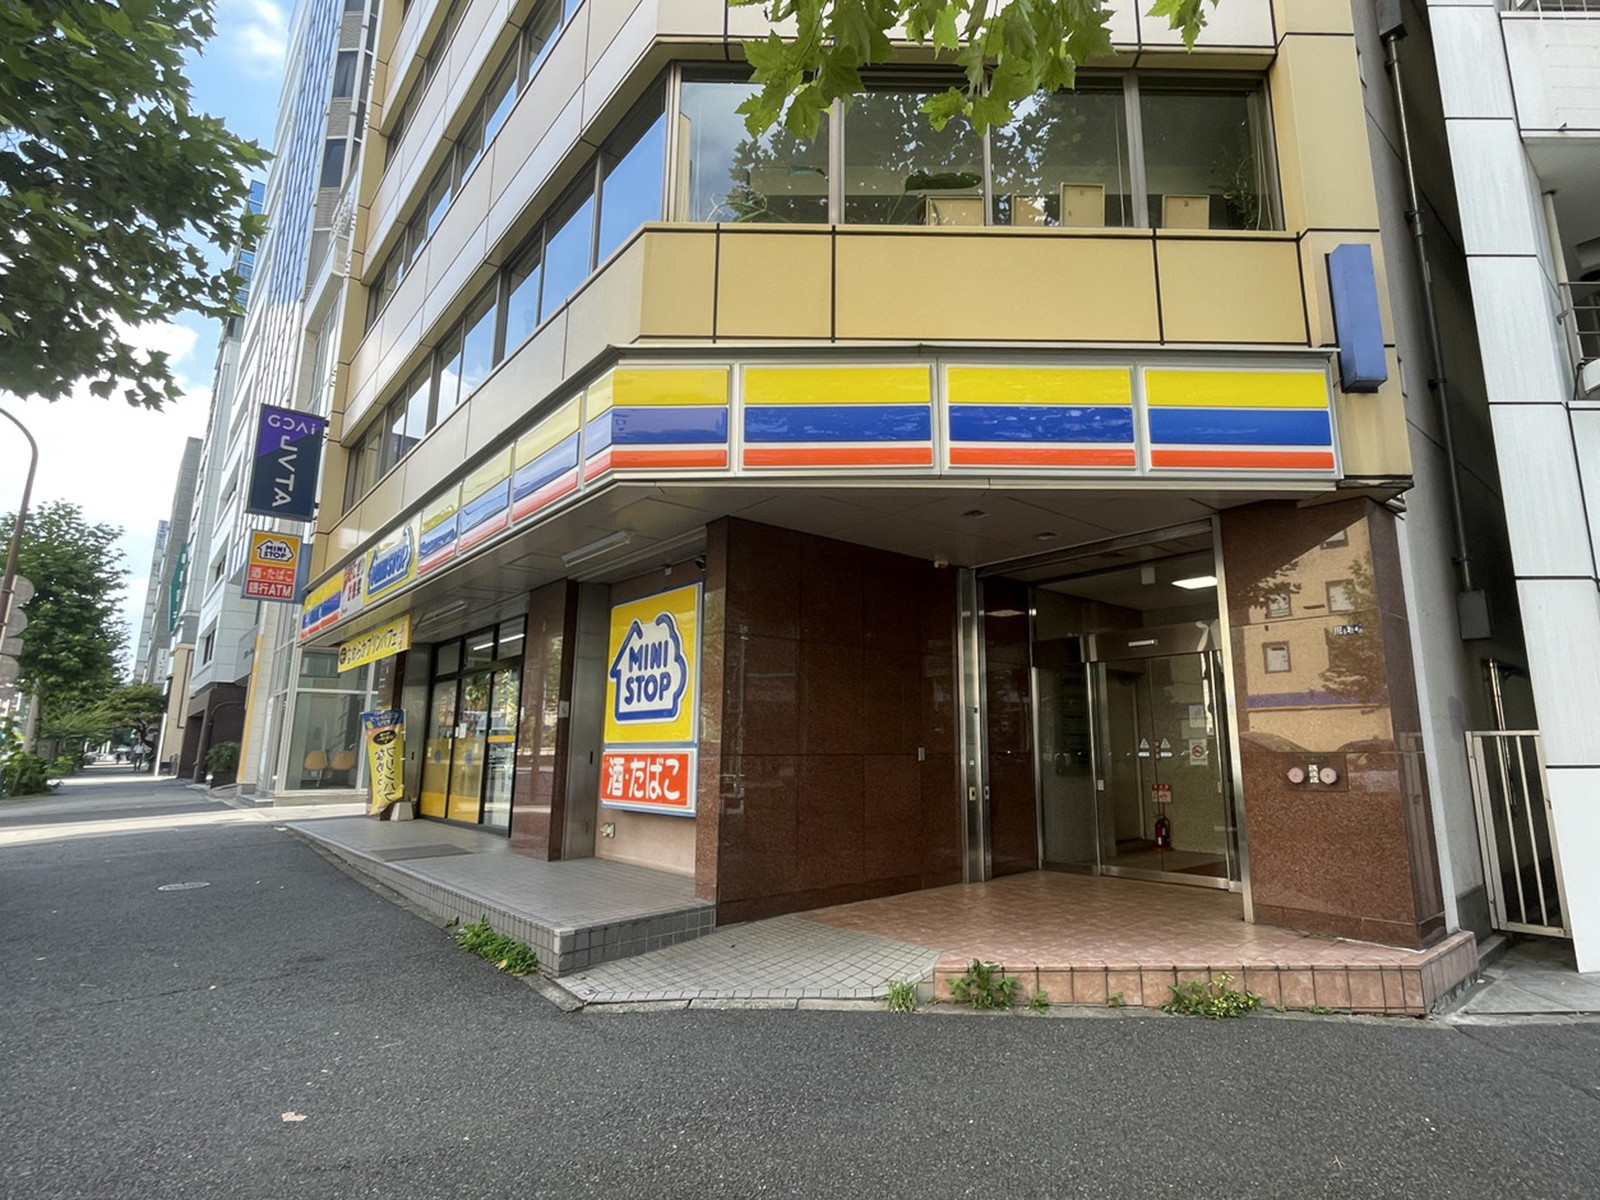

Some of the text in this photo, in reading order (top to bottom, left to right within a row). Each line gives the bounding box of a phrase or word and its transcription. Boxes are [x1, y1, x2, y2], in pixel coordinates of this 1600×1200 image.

[271, 435, 298, 508] JVTA
[263, 551, 287, 559] STOP
[248, 582, 292, 597] 銀行ATM
[628, 640, 669, 673] MINI
[624, 672, 672, 706] STOP
[607, 757, 681, 801] 酒・たばこ
